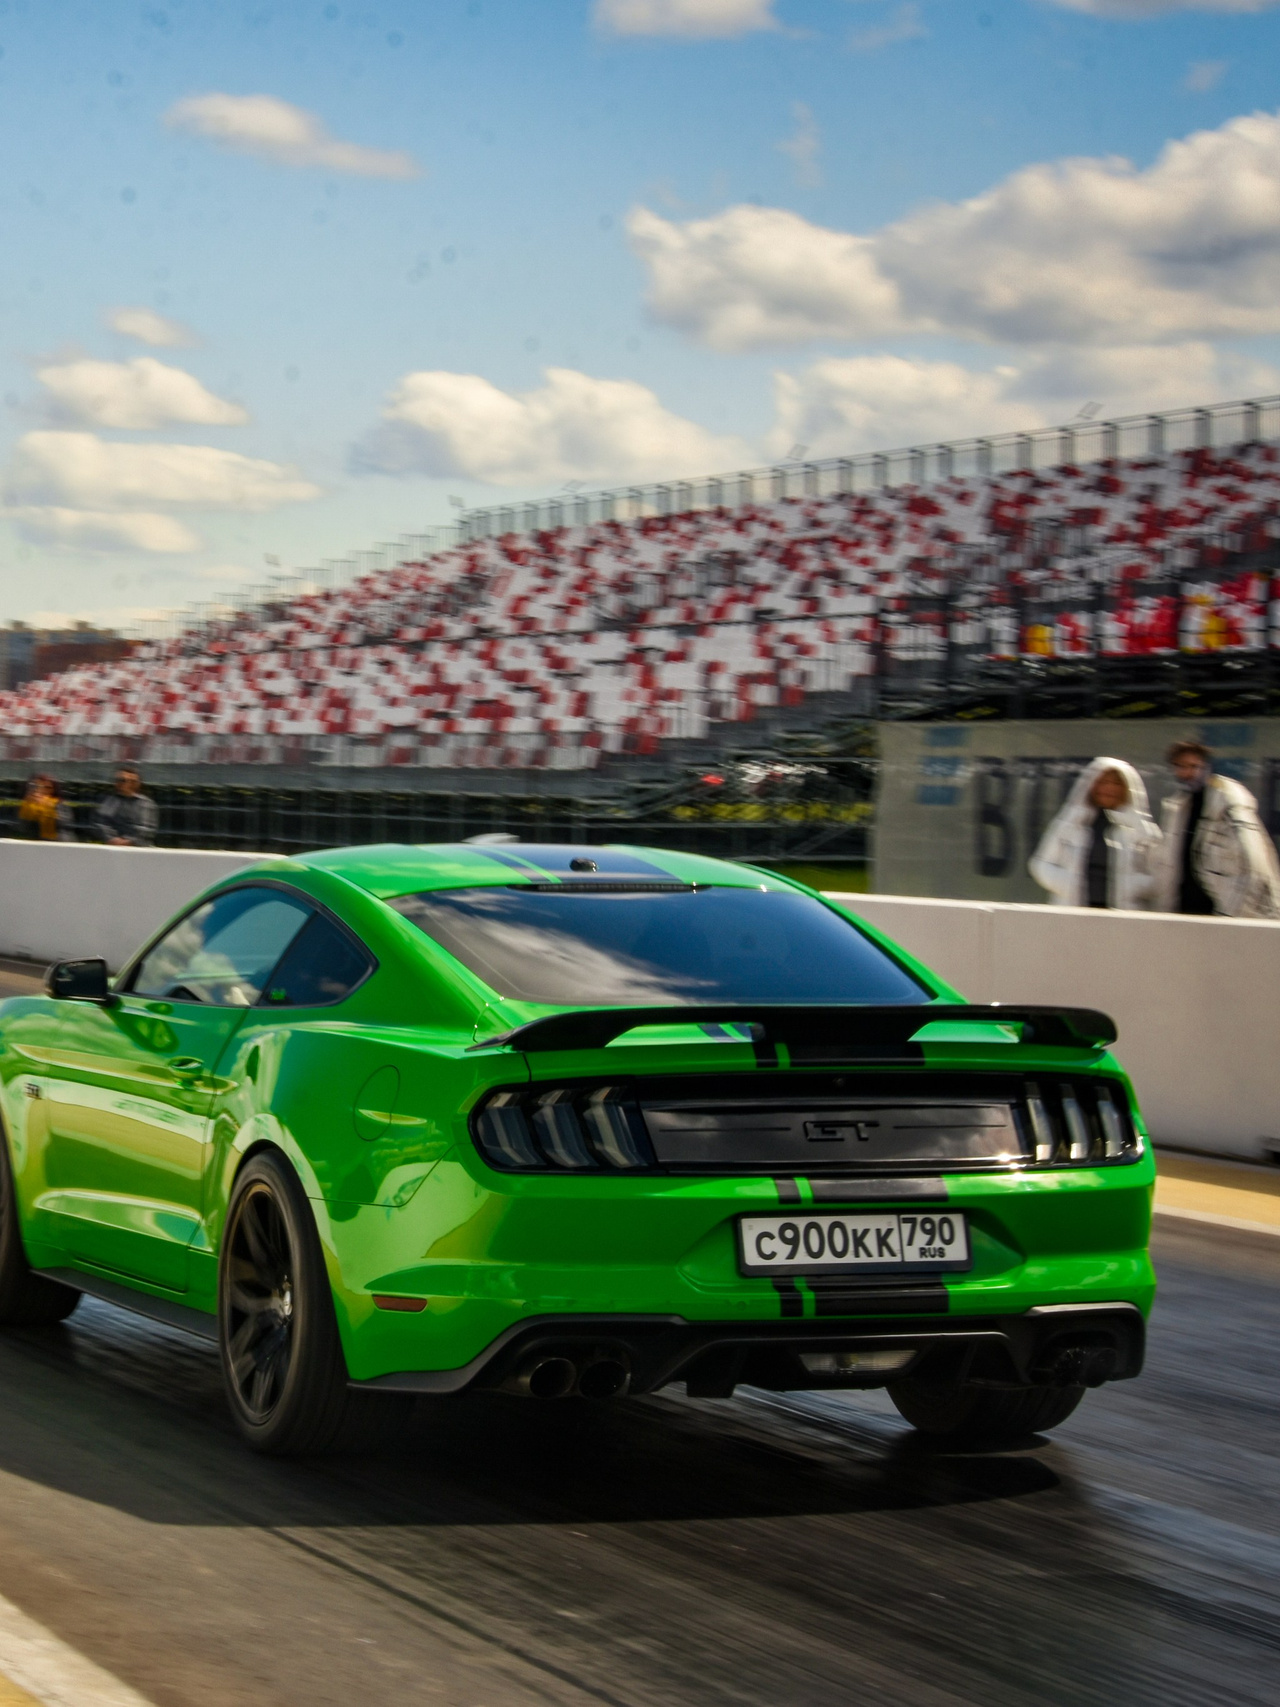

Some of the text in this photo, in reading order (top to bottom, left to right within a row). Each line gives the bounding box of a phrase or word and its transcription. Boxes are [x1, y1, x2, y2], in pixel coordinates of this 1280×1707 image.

[803, 1120, 880, 1142] GT
[901, 1216, 955, 1247] 790
[918, 1246, 946, 1259] RUS
